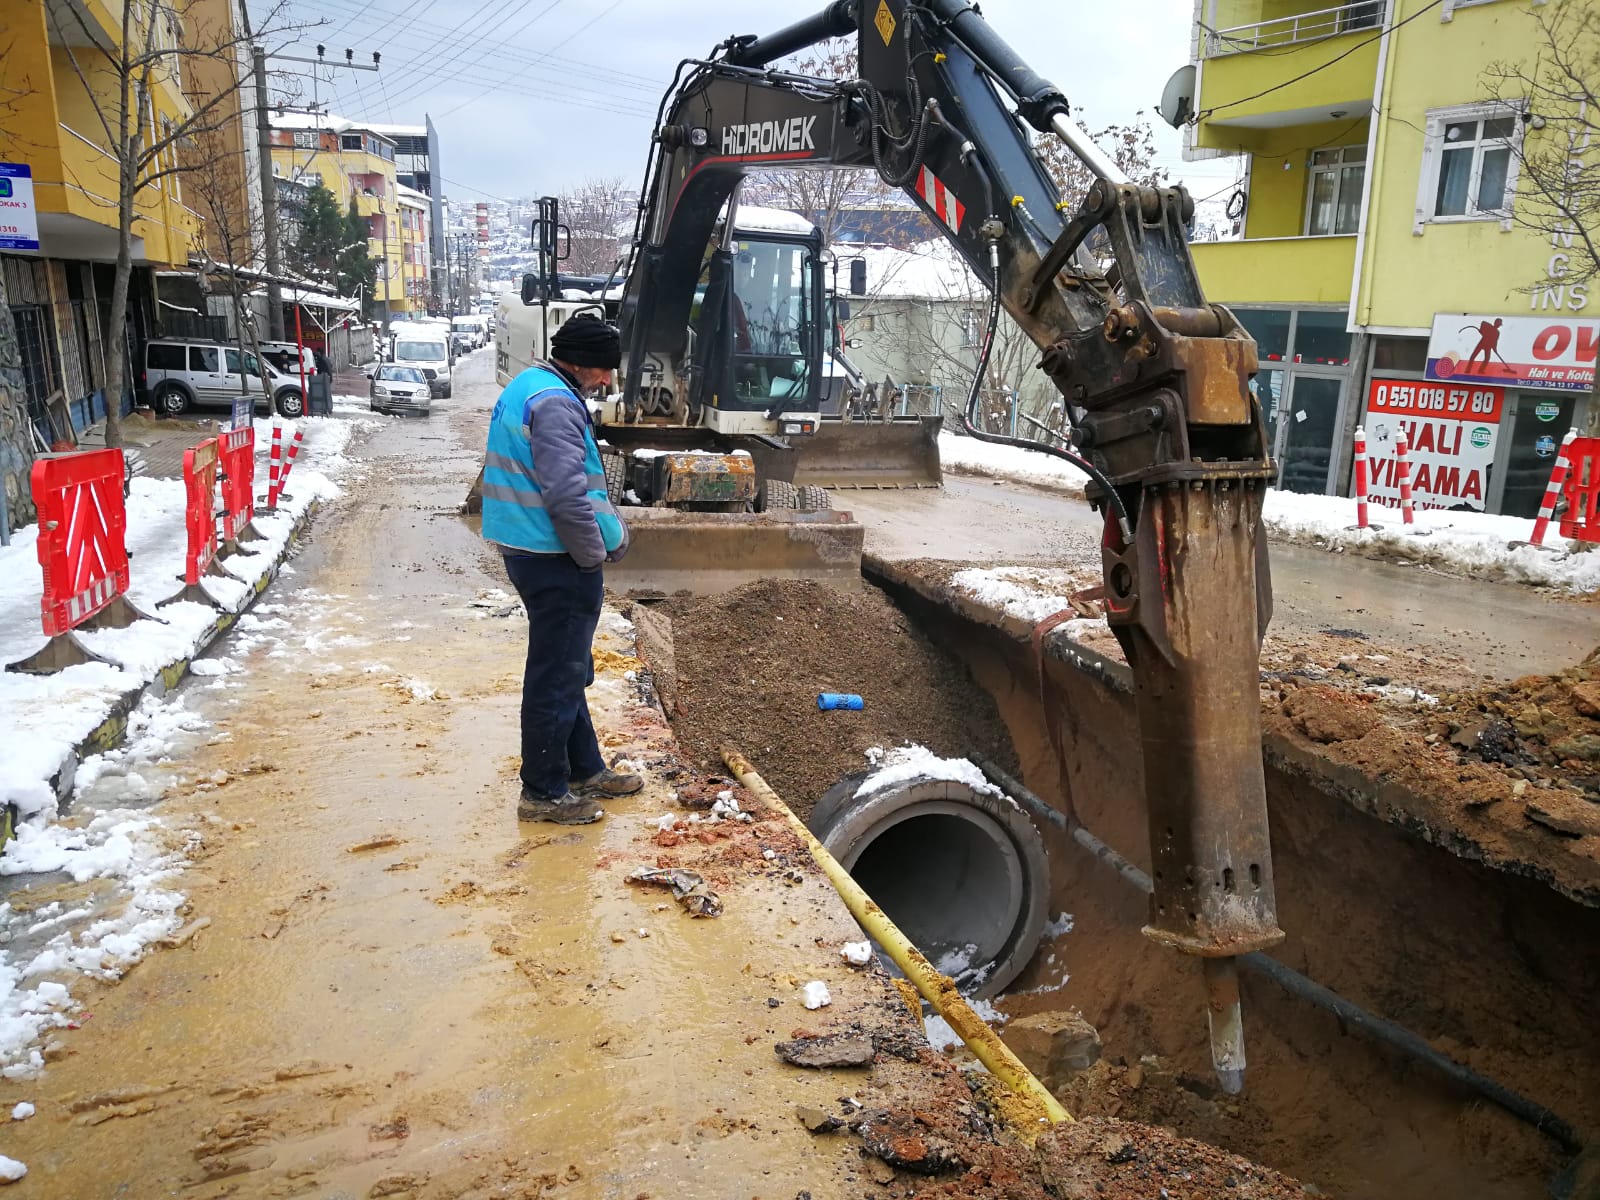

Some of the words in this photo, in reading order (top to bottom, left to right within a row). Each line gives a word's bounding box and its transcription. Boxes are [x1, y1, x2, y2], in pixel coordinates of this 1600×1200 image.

[1376, 385, 1388, 406] 0
[1389, 386, 1416, 408] 551
[1417, 388, 1445, 410] 018
[1447, 390, 1469, 412] 57
[1471, 391, 1495, 414] 80
